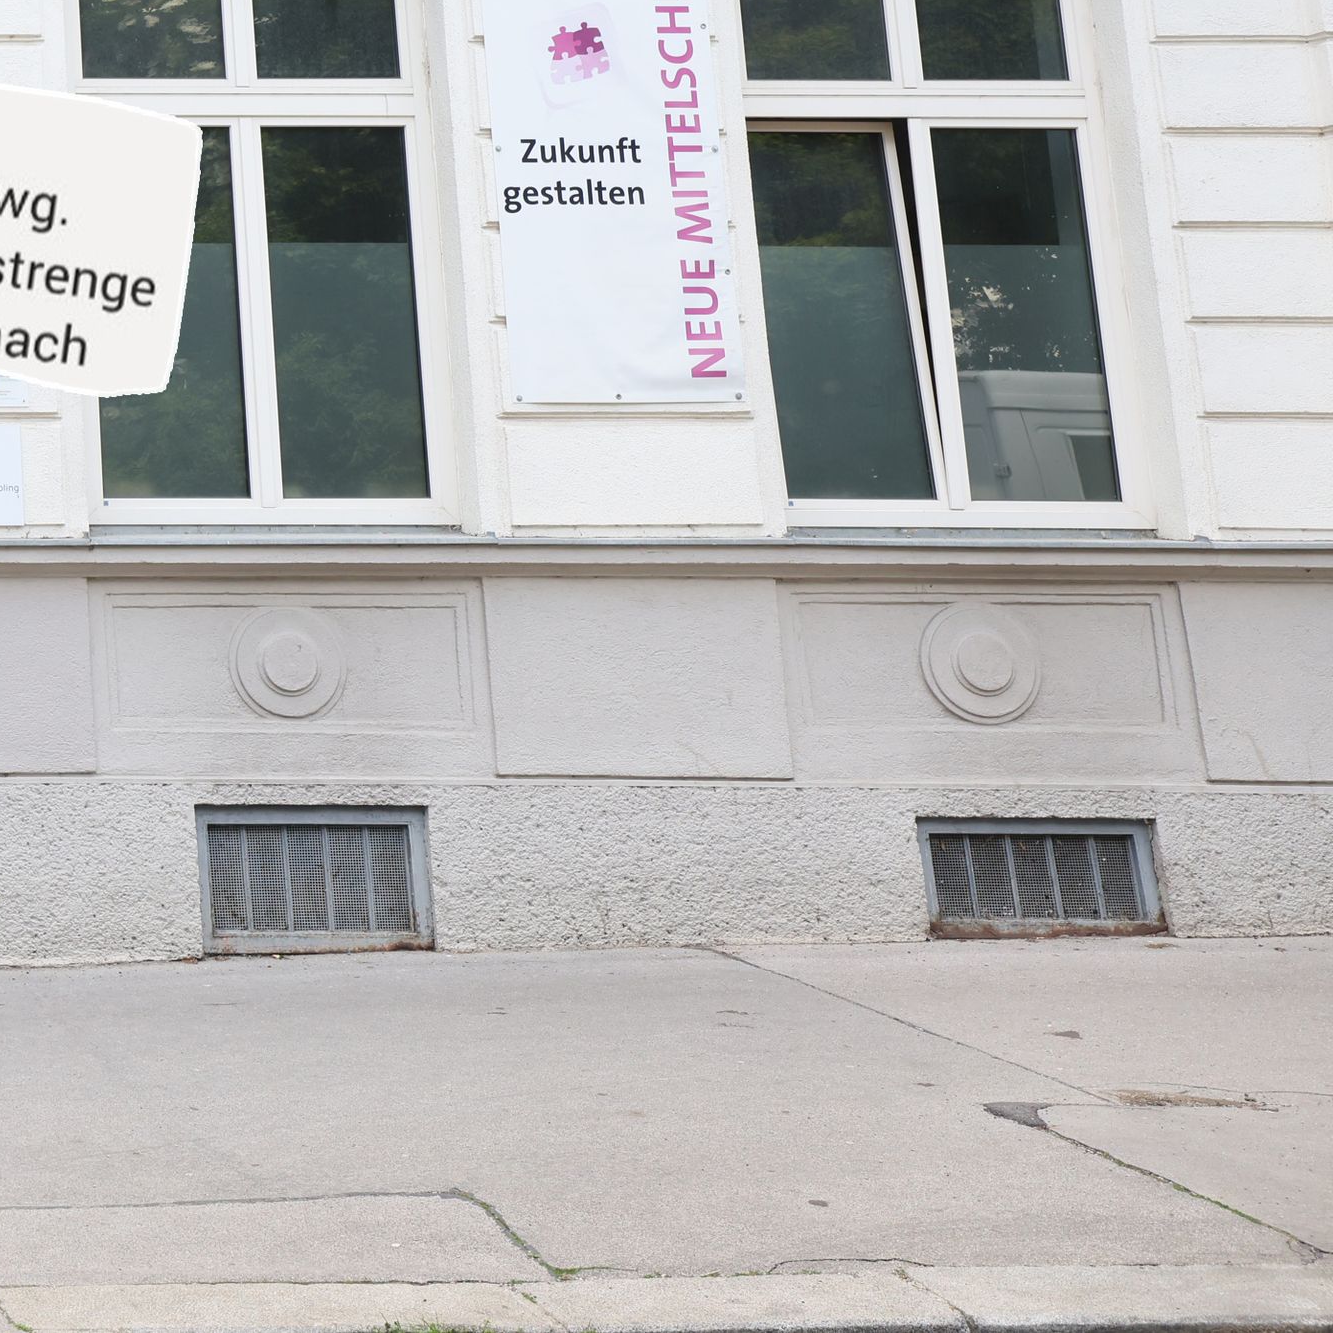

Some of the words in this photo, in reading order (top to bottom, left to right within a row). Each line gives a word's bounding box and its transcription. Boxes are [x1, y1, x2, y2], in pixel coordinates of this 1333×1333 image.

[520, 136, 642, 164] Zukunft
[503, 178, 645, 214] gestalten
[680, 260, 727, 379] NEUE
